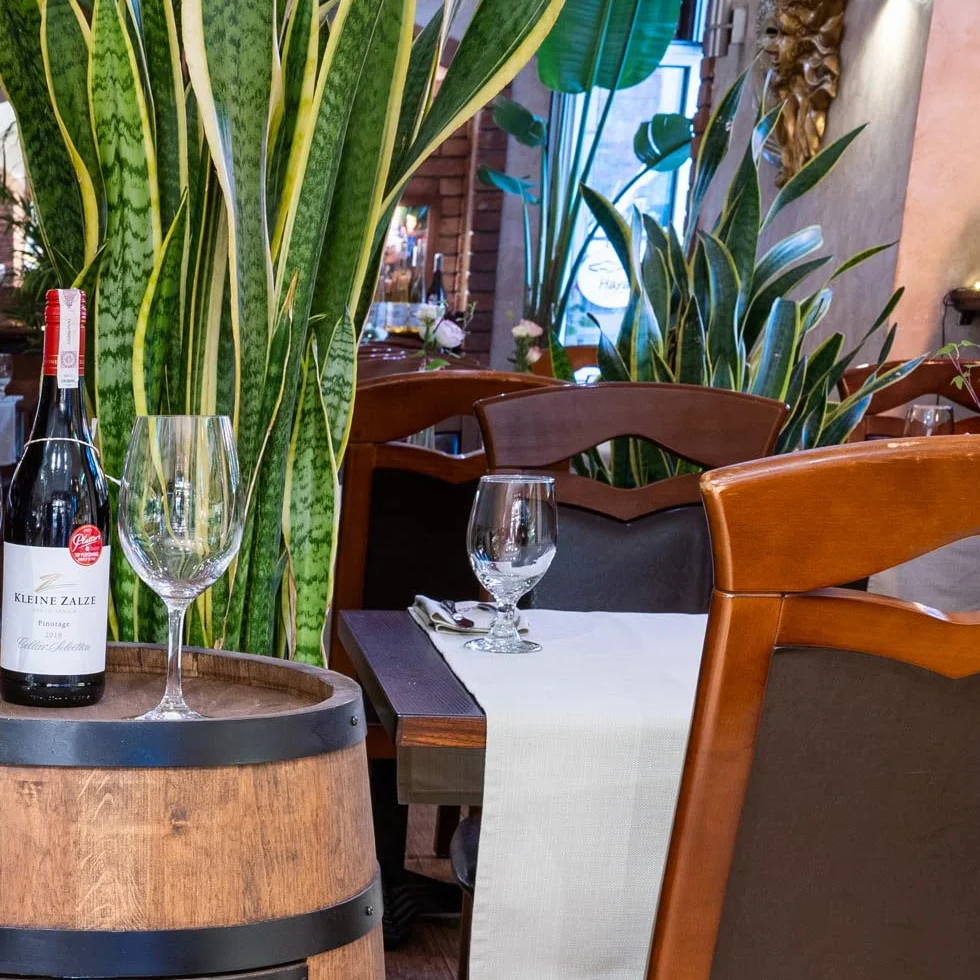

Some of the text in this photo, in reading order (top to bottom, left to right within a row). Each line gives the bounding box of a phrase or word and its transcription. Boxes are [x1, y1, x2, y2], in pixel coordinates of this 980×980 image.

[14, 592, 97, 606] KLEINE ZALZE
[38, 619, 71, 629] Pinotage
